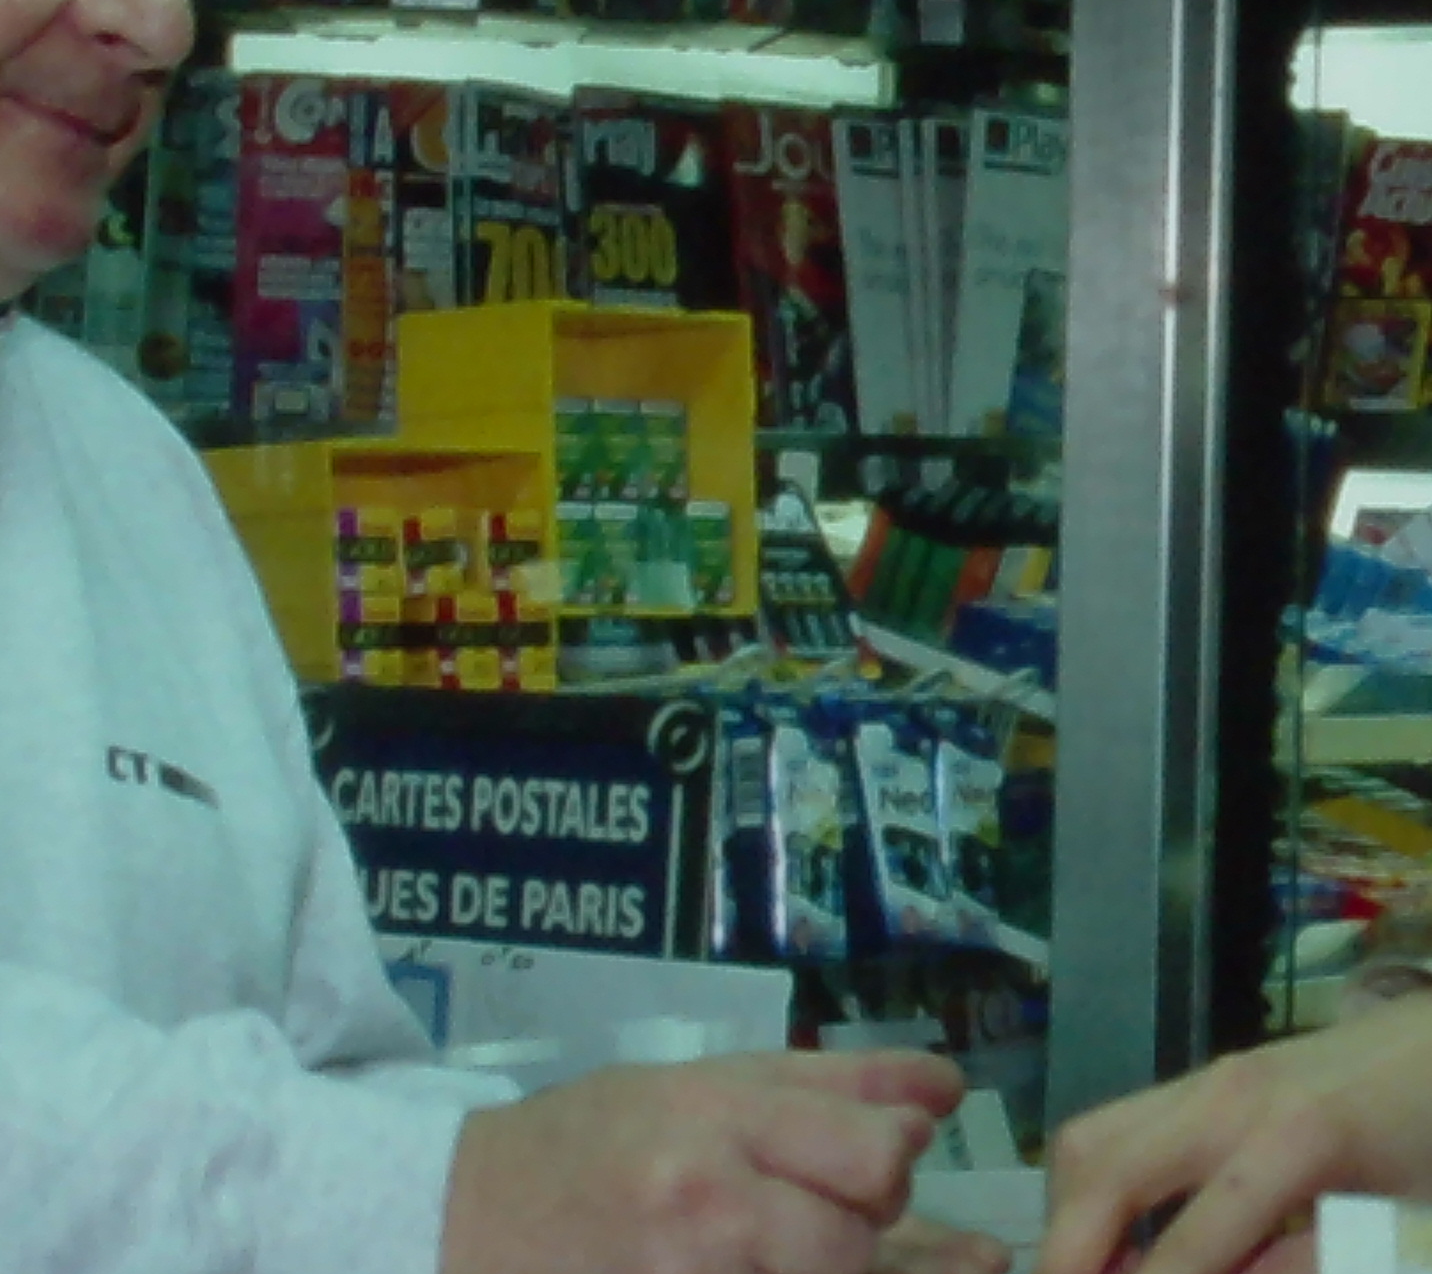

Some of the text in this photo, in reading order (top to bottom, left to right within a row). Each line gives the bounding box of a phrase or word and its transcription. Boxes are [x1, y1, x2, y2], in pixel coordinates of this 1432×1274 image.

[589, 208, 677, 286] 300
[333, 766, 653, 845] CARTES POSTALES
[366, 869, 647, 941] UES DE PARIS
